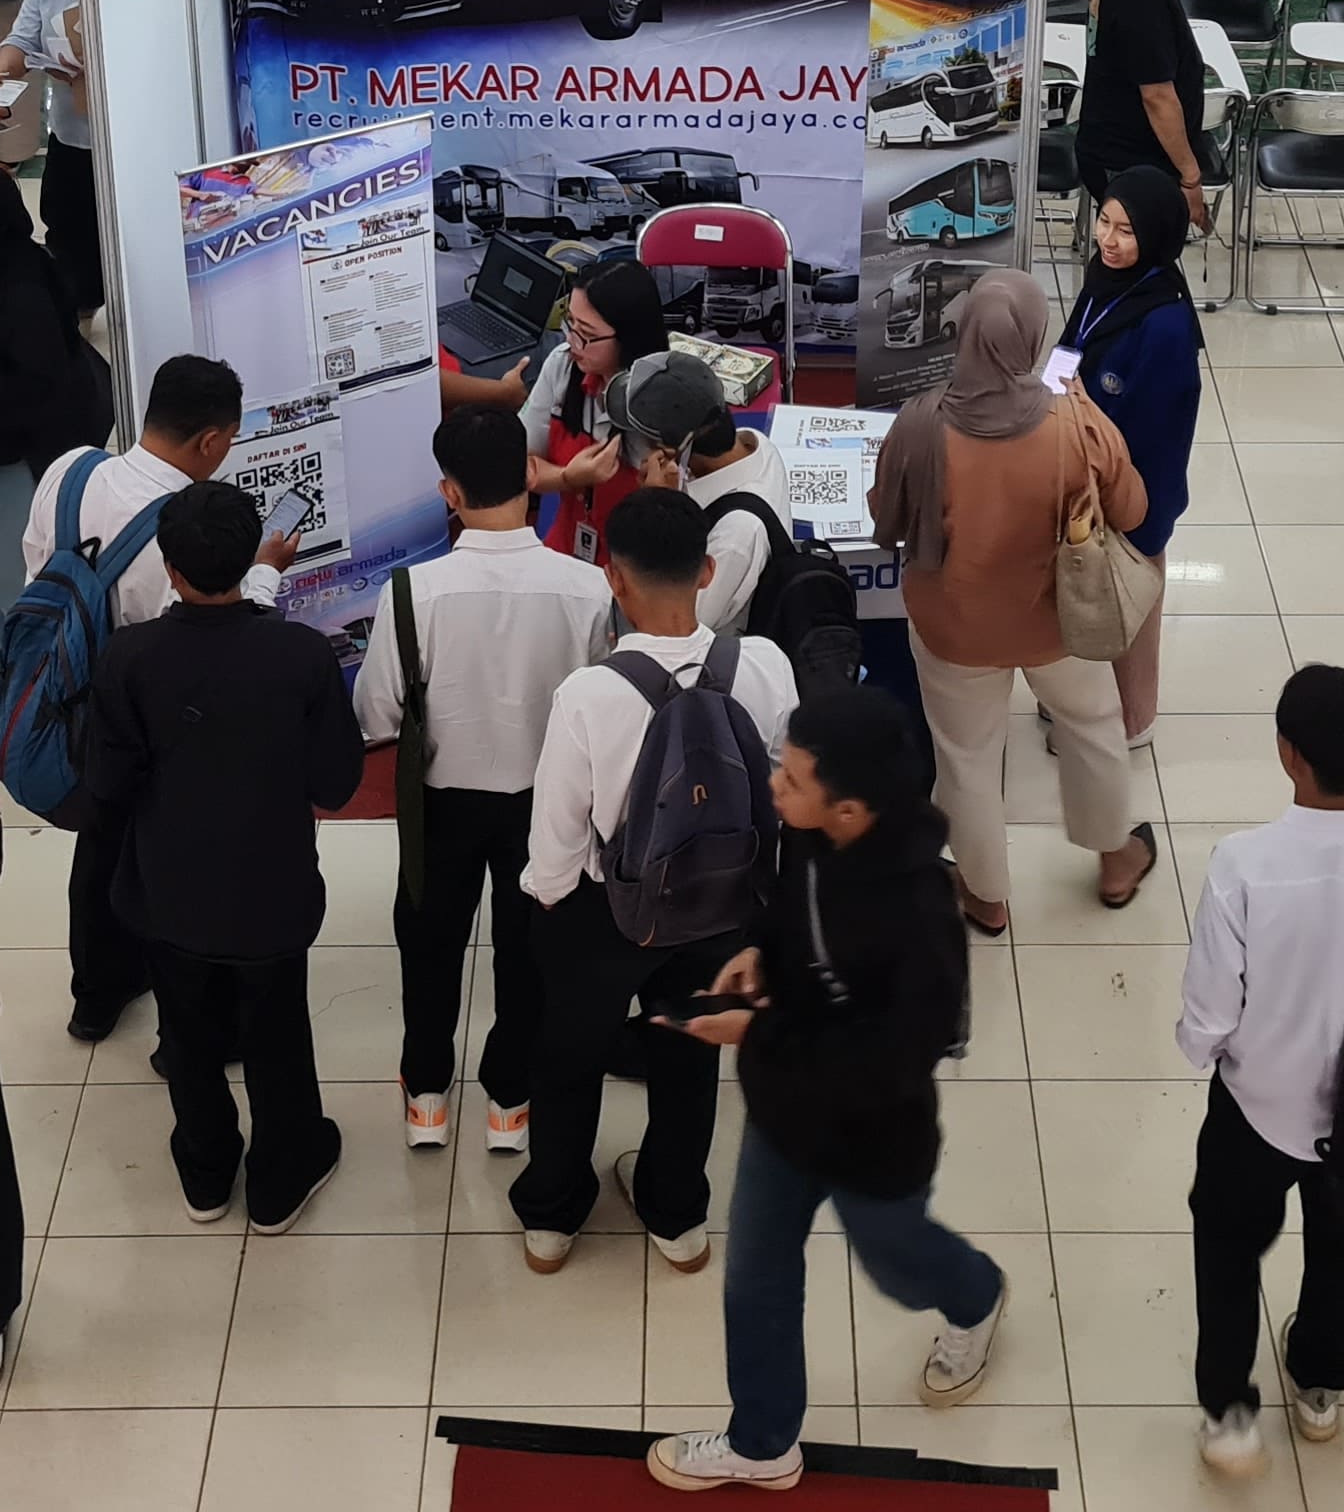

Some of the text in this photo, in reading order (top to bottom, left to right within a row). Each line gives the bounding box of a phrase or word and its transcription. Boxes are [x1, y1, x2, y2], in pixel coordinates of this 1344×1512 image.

[290, 64, 868, 107] PT. MEKAR ARMADA JAY
[202, 157, 422, 265] VACANCIES
[360, 226, 425, 248] Join Our Team
[344, 246, 403, 267] OPEN POSITION
[269, 411, 334, 435] Join Our Team
[247, 442, 307, 464] DAFTAR DI SINI
[295, 546, 408, 588] new armada
